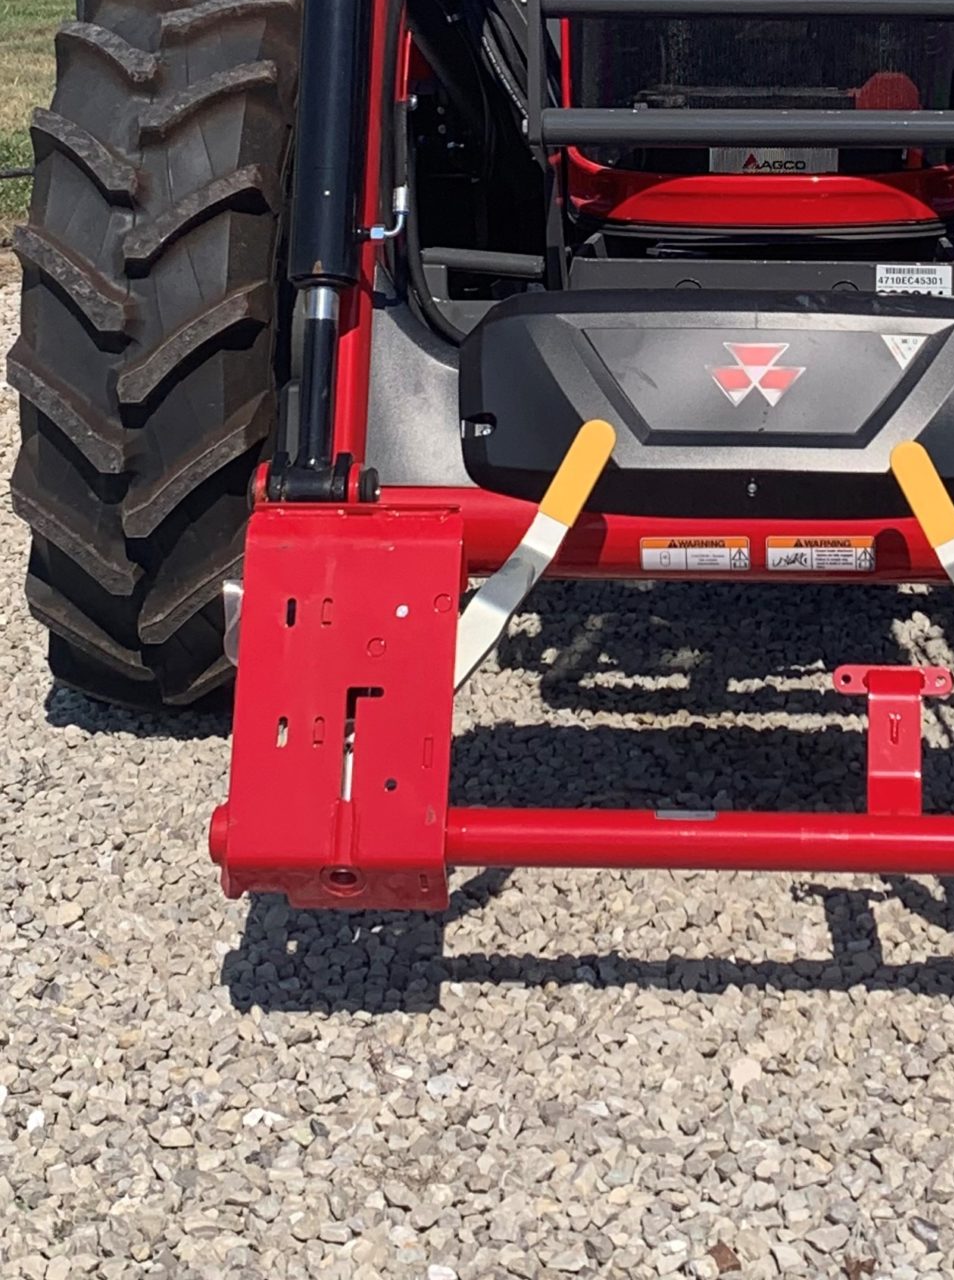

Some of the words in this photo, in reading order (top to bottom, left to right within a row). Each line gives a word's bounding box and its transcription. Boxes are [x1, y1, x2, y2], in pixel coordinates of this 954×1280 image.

[760, 160, 806, 170] AGCO
[878, 276, 943, 286] 4710EC45301
[678, 539, 726, 548] WARNING
[803, 539, 852, 548] WARNING
